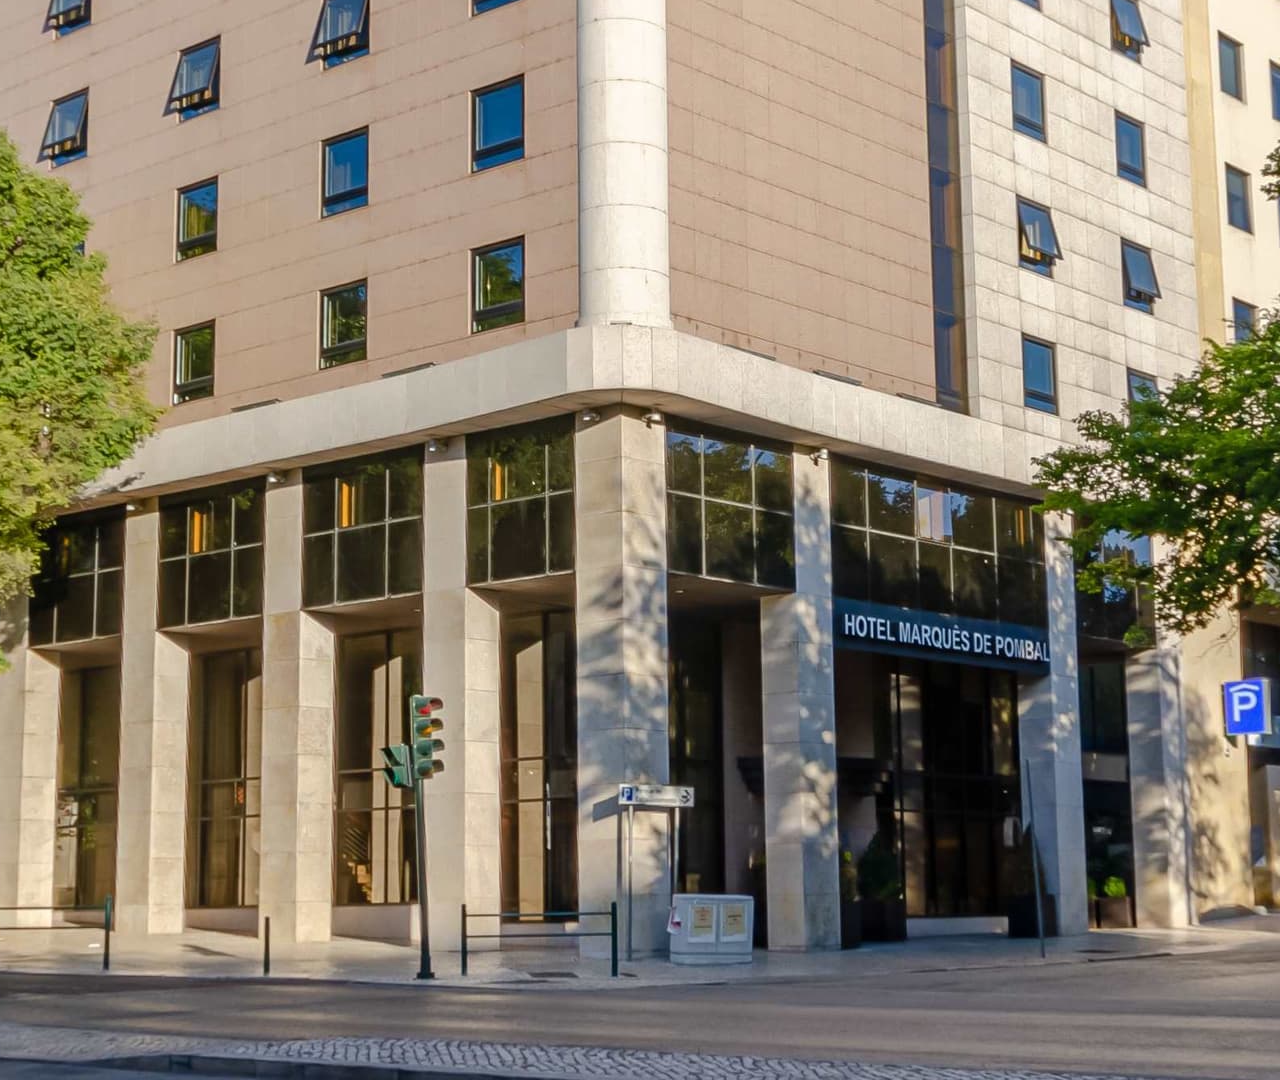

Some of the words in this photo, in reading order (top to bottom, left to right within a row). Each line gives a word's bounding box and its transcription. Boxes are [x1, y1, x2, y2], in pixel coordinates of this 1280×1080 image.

[845, 613, 895, 641] HOTEL
[899, 622, 970, 651] MARQUÊS
[974, 633, 993, 655] DE
[996, 636, 1050, 662] POMBAL
[1232, 691, 1258, 722] P
[623, 788, 631, 801] P
